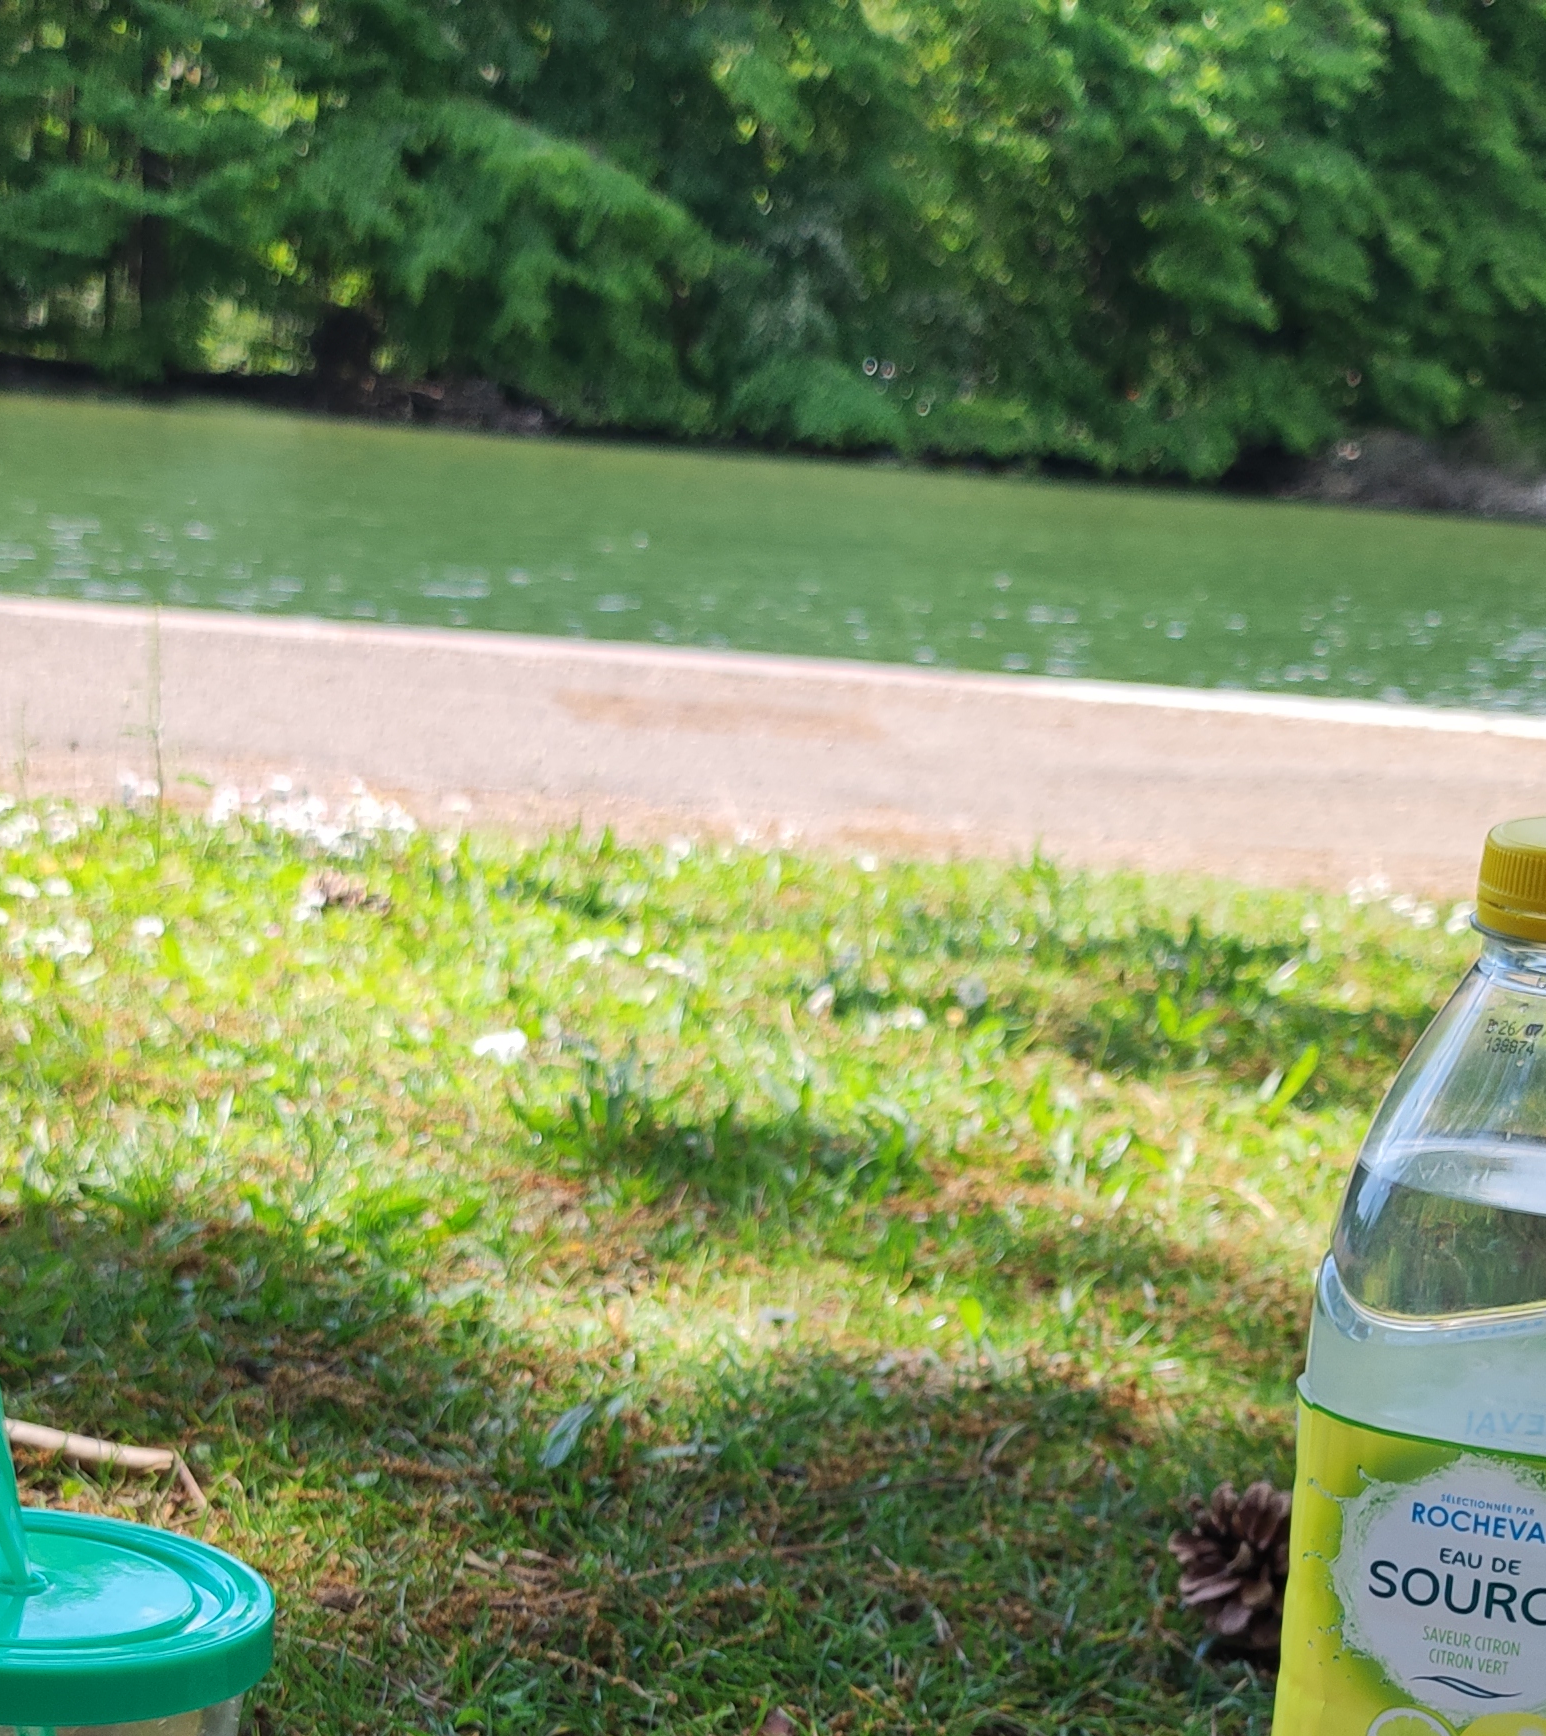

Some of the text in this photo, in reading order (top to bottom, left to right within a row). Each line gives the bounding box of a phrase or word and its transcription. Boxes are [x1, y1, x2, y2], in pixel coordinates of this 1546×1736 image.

[1516, 1506, 1535, 1517] PAR
[1439, 1547, 1522, 1576] EAU DE
[1422, 1625, 1521, 1657] SAVEUR CITRON
[1429, 1648, 1509, 1676] CITRON VERT
